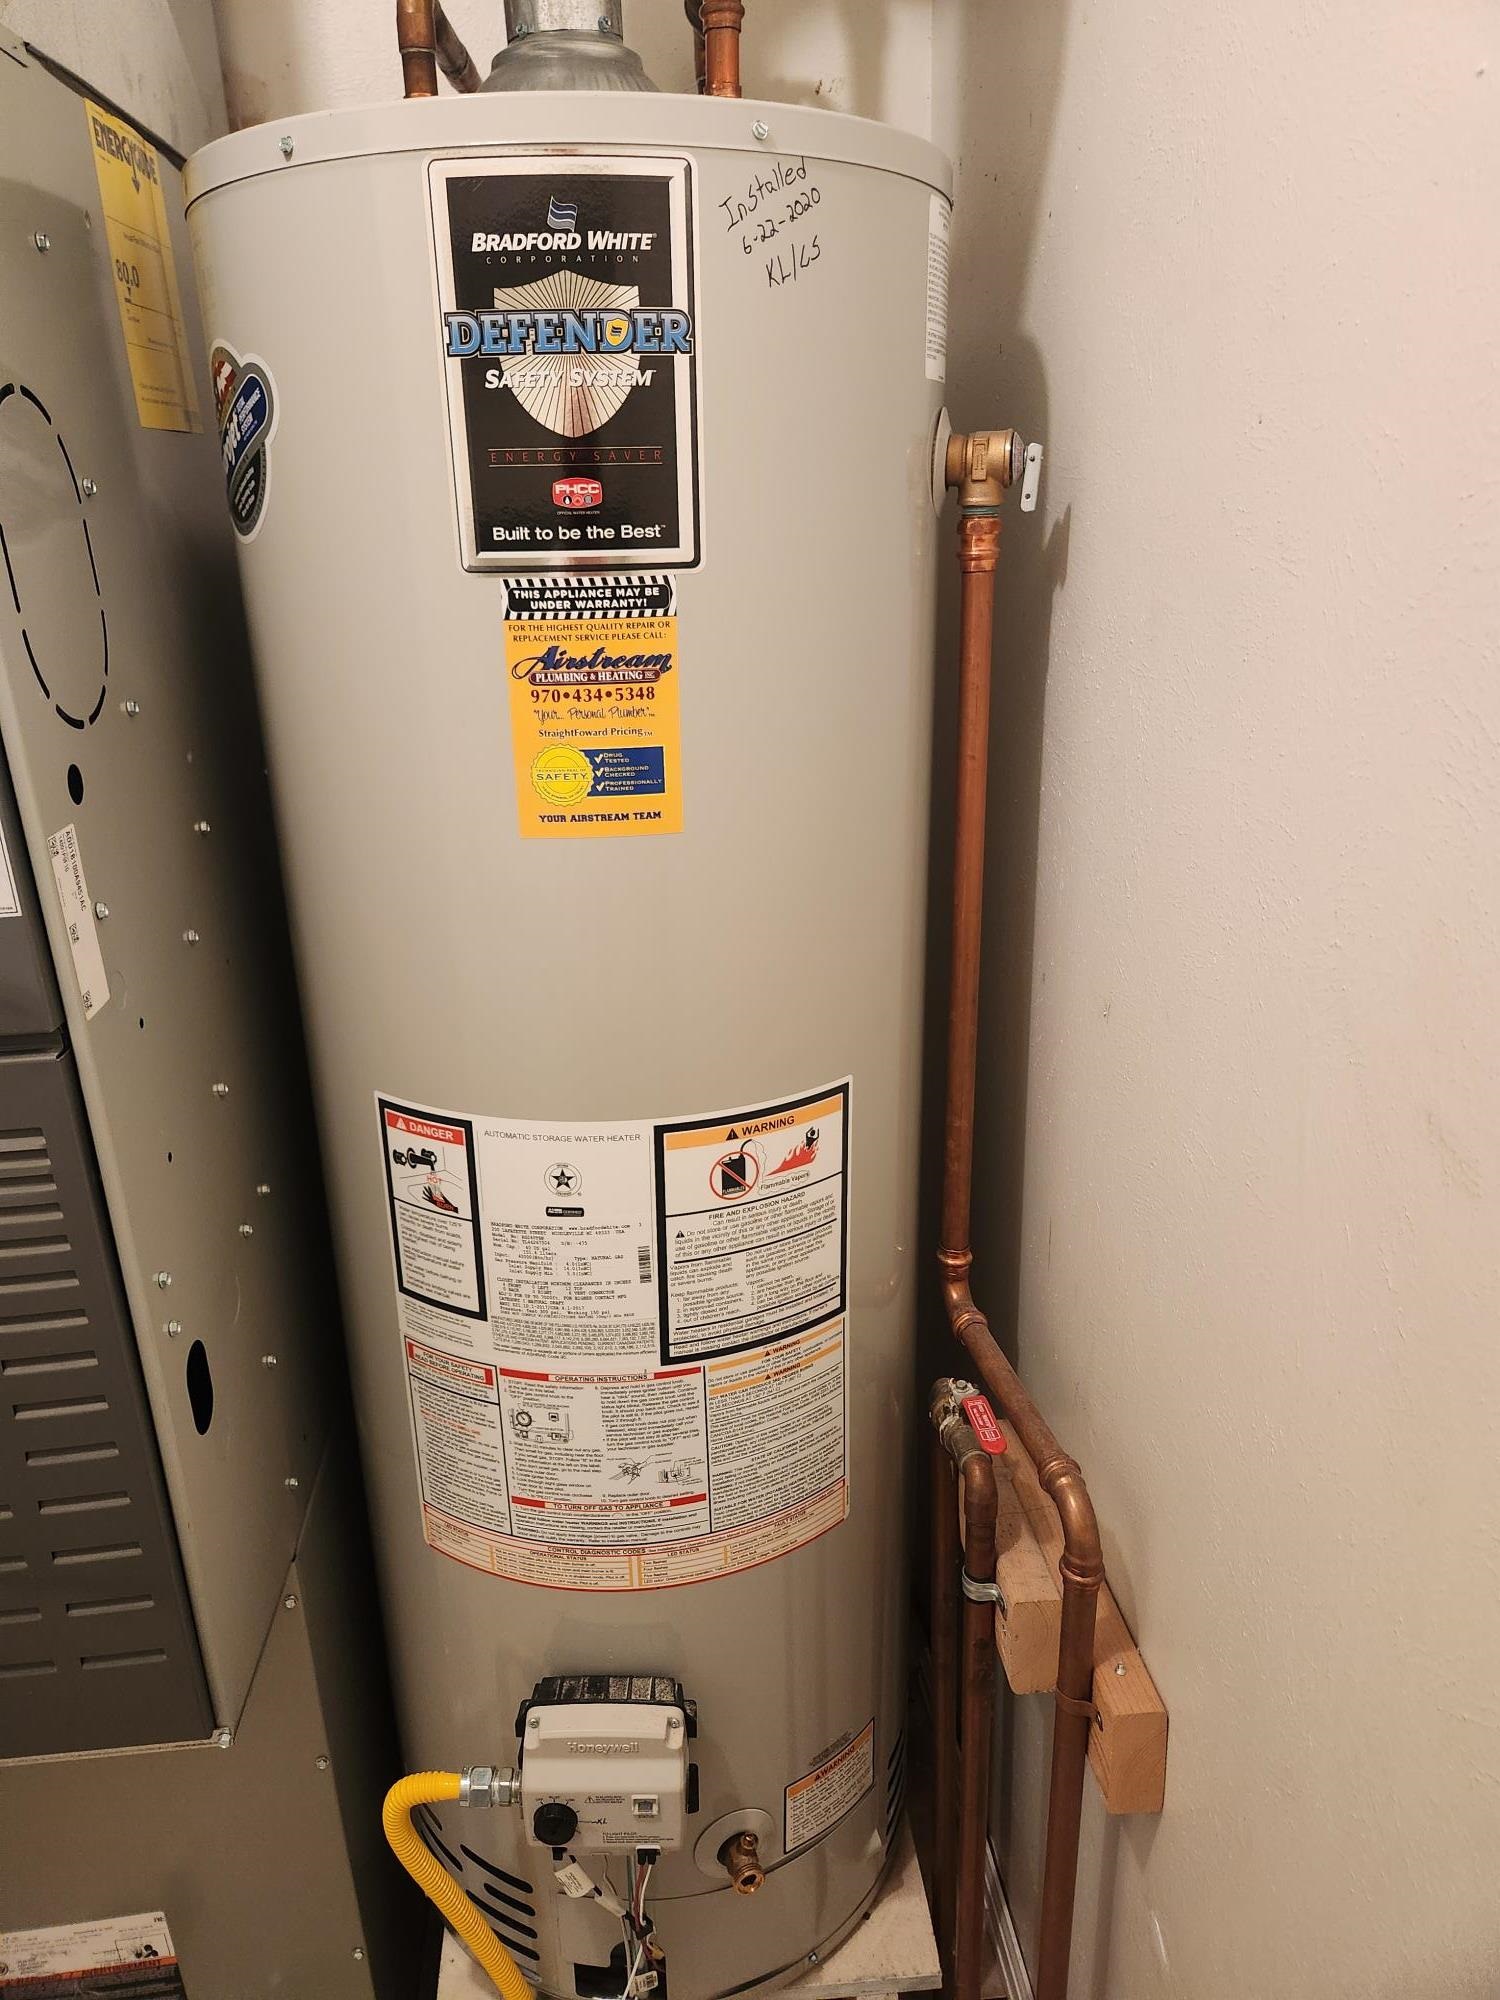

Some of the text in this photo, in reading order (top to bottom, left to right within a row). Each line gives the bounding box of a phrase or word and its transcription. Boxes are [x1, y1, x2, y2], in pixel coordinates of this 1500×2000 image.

[718, 156, 807, 232] Installed
[742, 187, 821, 255] 6-22-2020
[471, 230, 653, 253] BRADFORD WHITE
[486, 254, 640, 265] CORPORATION
[115, 259, 140, 289] 80.0
[446, 308, 693, 356] DEFENDER
[484, 369, 564, 389] SAFETY
[490, 450, 662, 463] ENERGY SAVER
[555, 484, 600, 494] PHCC
[492, 526, 531, 541] Built
[535, 527, 553, 541] to
[558, 526, 582, 540] be
[586, 525, 615, 539] the
[513, 587, 660, 599] THIS APPLIANCE MAY BE
[530, 598, 648, 610] UNDER WARRANTY!
[509, 621, 671, 632] FOR THE HIGHEST QUALITY REPAIR OR
[513, 631, 667, 643] REPLACEMENT SERVICE PLEASE CALL:
[512, 645, 673, 680] Airstream
[535, 672, 588, 683] PLUMBING
[598, 670, 643, 681] HEATING
[567, 706, 607, 720] Personal
[538, 728, 609, 740] StraightFoward
[536, 773, 588, 781] SAFETY
[604, 778, 663, 787] PROFESSIONALLY
[539, 811, 662, 823] YOUR AIRSTREAM TEAM
[409, 1122, 454, 1141] DANGER
[741, 1115, 796, 1137] WARNING
[484, 1130, 641, 1143] AUTOMATIC STORAGE WATER HEATER
[426, 1174, 442, 1185] HOT
[760, 1171, 810, 1190] Flammable Vapors
[709, 1191, 806, 1220] FIRE AND EXPLOSION HAZARD
[740, 1216, 762, 1228] gasoline
[783, 1204, 809, 1214] flammable
[809, 1198, 824, 1207] vapors
[748, 1210, 767, 1218] serious
[675, 1237, 694, 1246] liquids
[711, 1231, 730, 1241] vicinity
[755, 1222, 766, 1231] any
[700, 1248, 712, 1256] any
[772, 1338, 801, 1355] WARNING
[423, 1351, 473, 1372] FOR YOUR SAFETY
[761, 1346, 801, 1364] FOR YOUR SAFETY
[428, 1359, 449, 1370] BEFORE
[450, 1367, 485, 1381] OPERATING
[773, 1362, 801, 1377] WARNING
[596, 1374, 648, 1382] INSTRUCTIONS
[625, 1502, 664, 1510] APPLIANCE
[530, 1550, 566, 1560] OPERATIONAL
[547, 1546, 580, 1555] CONTROL
[567, 1741, 640, 1754] Honeywell
[820, 1745, 855, 1777] WARNING
